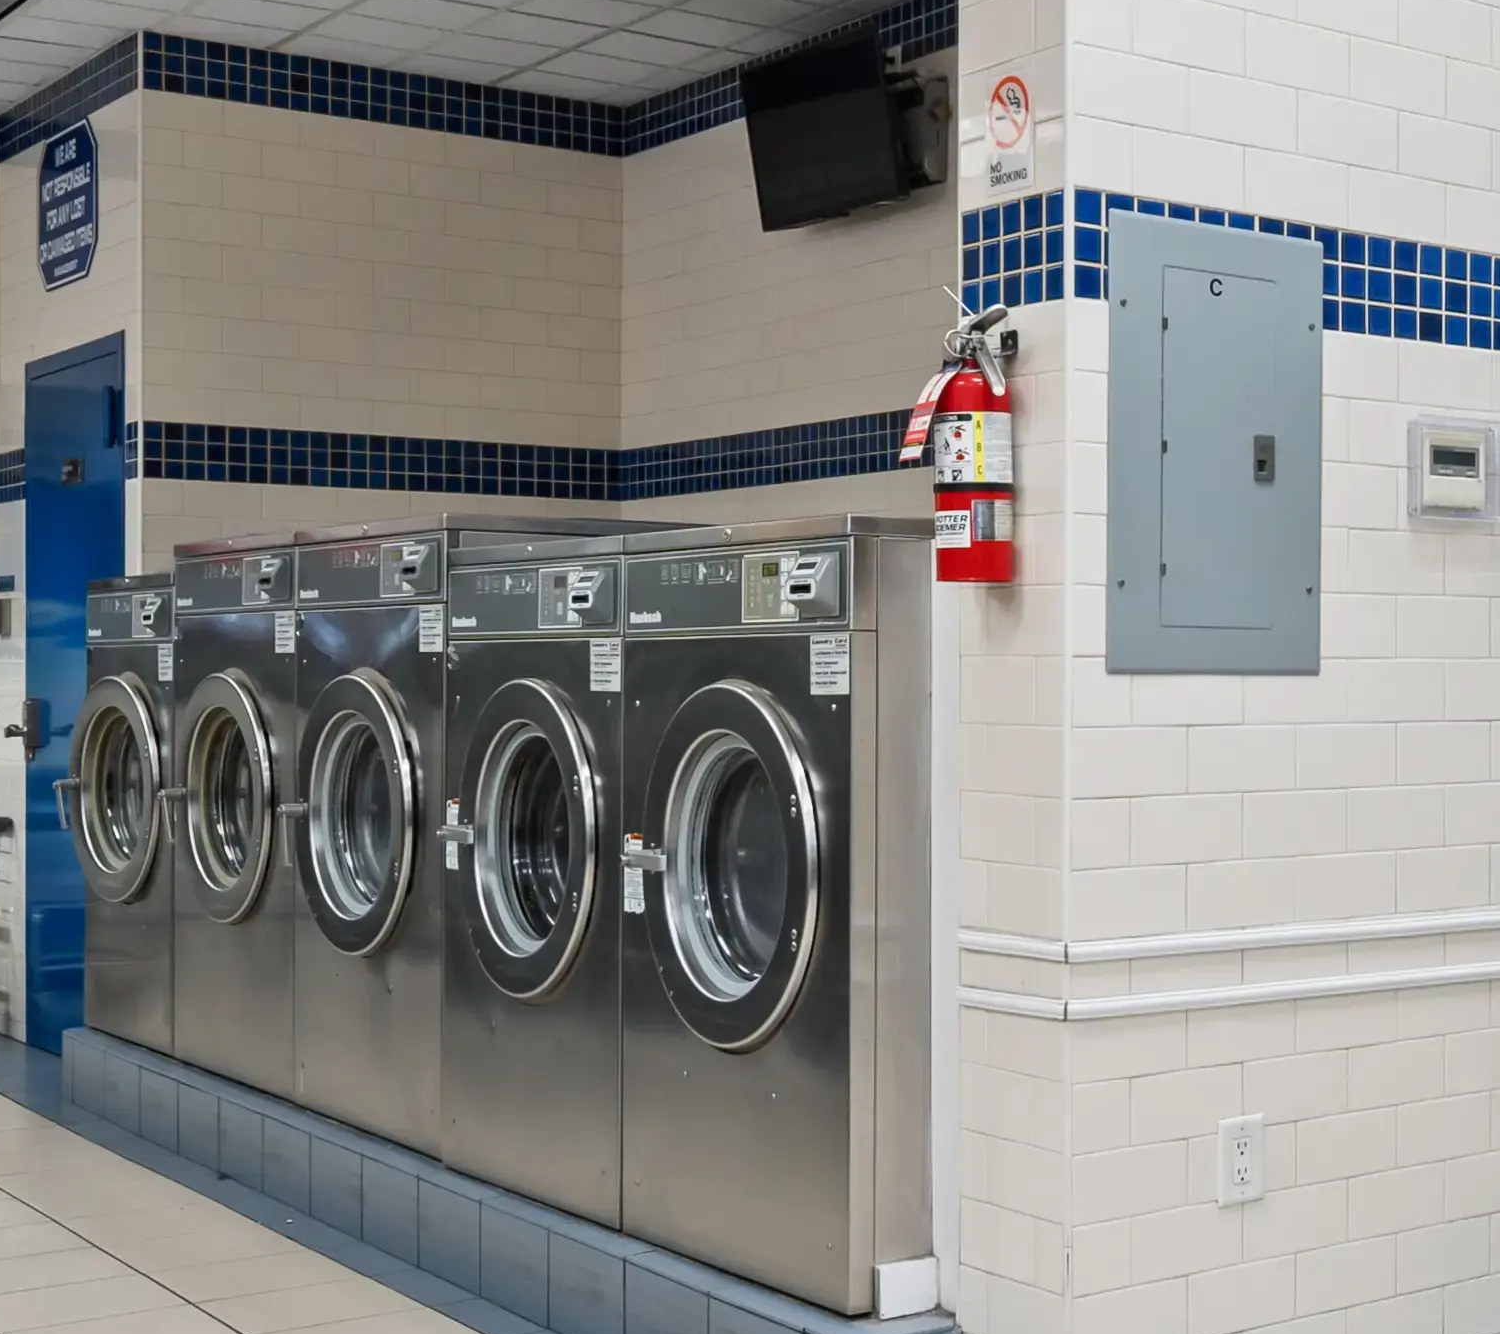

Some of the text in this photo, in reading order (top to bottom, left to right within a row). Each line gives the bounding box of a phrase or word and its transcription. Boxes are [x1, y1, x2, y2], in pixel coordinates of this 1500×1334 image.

[990, 162, 1002, 174] NO
[990, 168, 1027, 187] SMOKING
[1209, 278, 1224, 297] C
[976, 420, 981, 429] A
[977, 443, 981, 452] B
[977, 465, 982, 475] C
